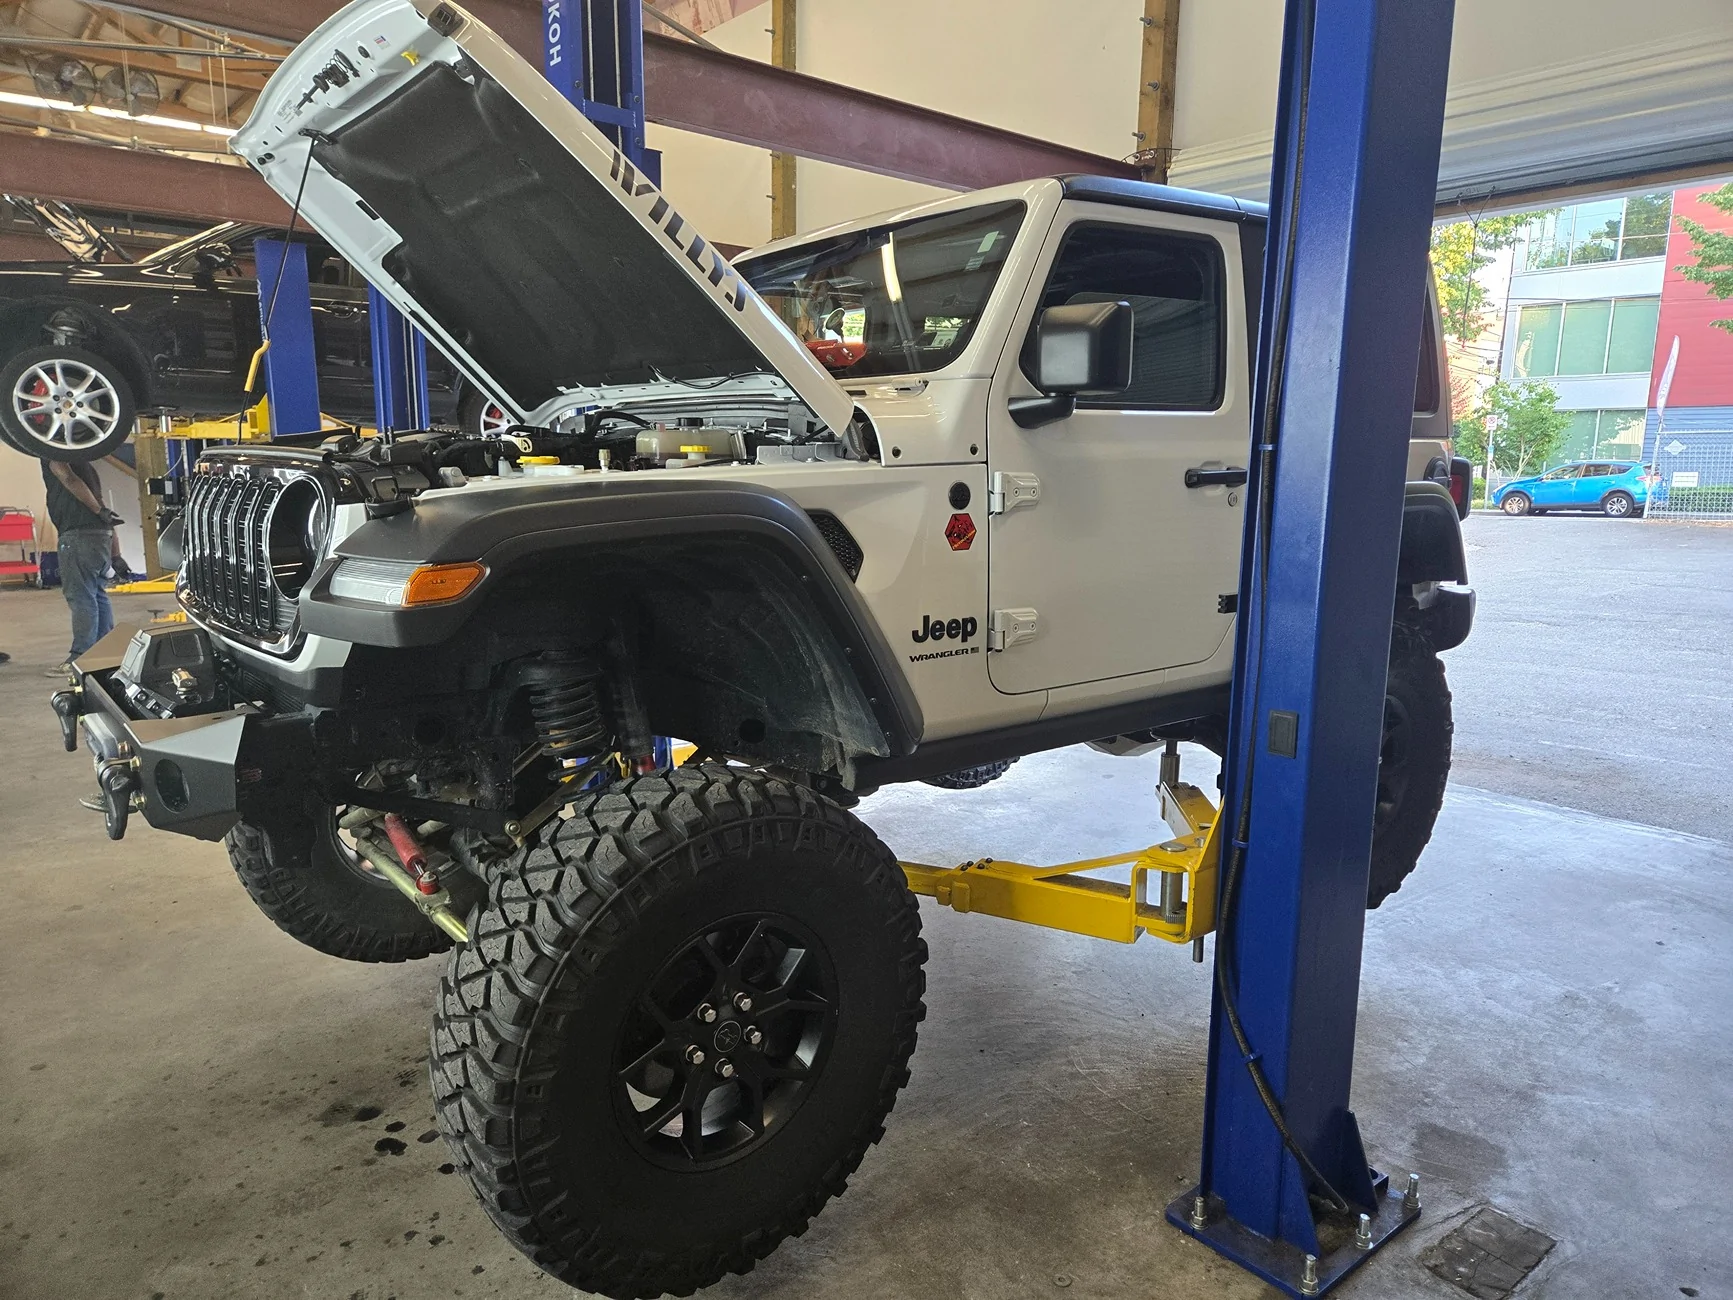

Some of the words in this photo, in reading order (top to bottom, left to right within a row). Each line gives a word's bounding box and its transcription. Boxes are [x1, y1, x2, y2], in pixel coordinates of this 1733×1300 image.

[548, 0, 562, 67] KOH
[610, 149, 747, 312] WILLYS
[911, 614, 978, 644] Jeep
[909, 648, 969, 663] WRANGLER
